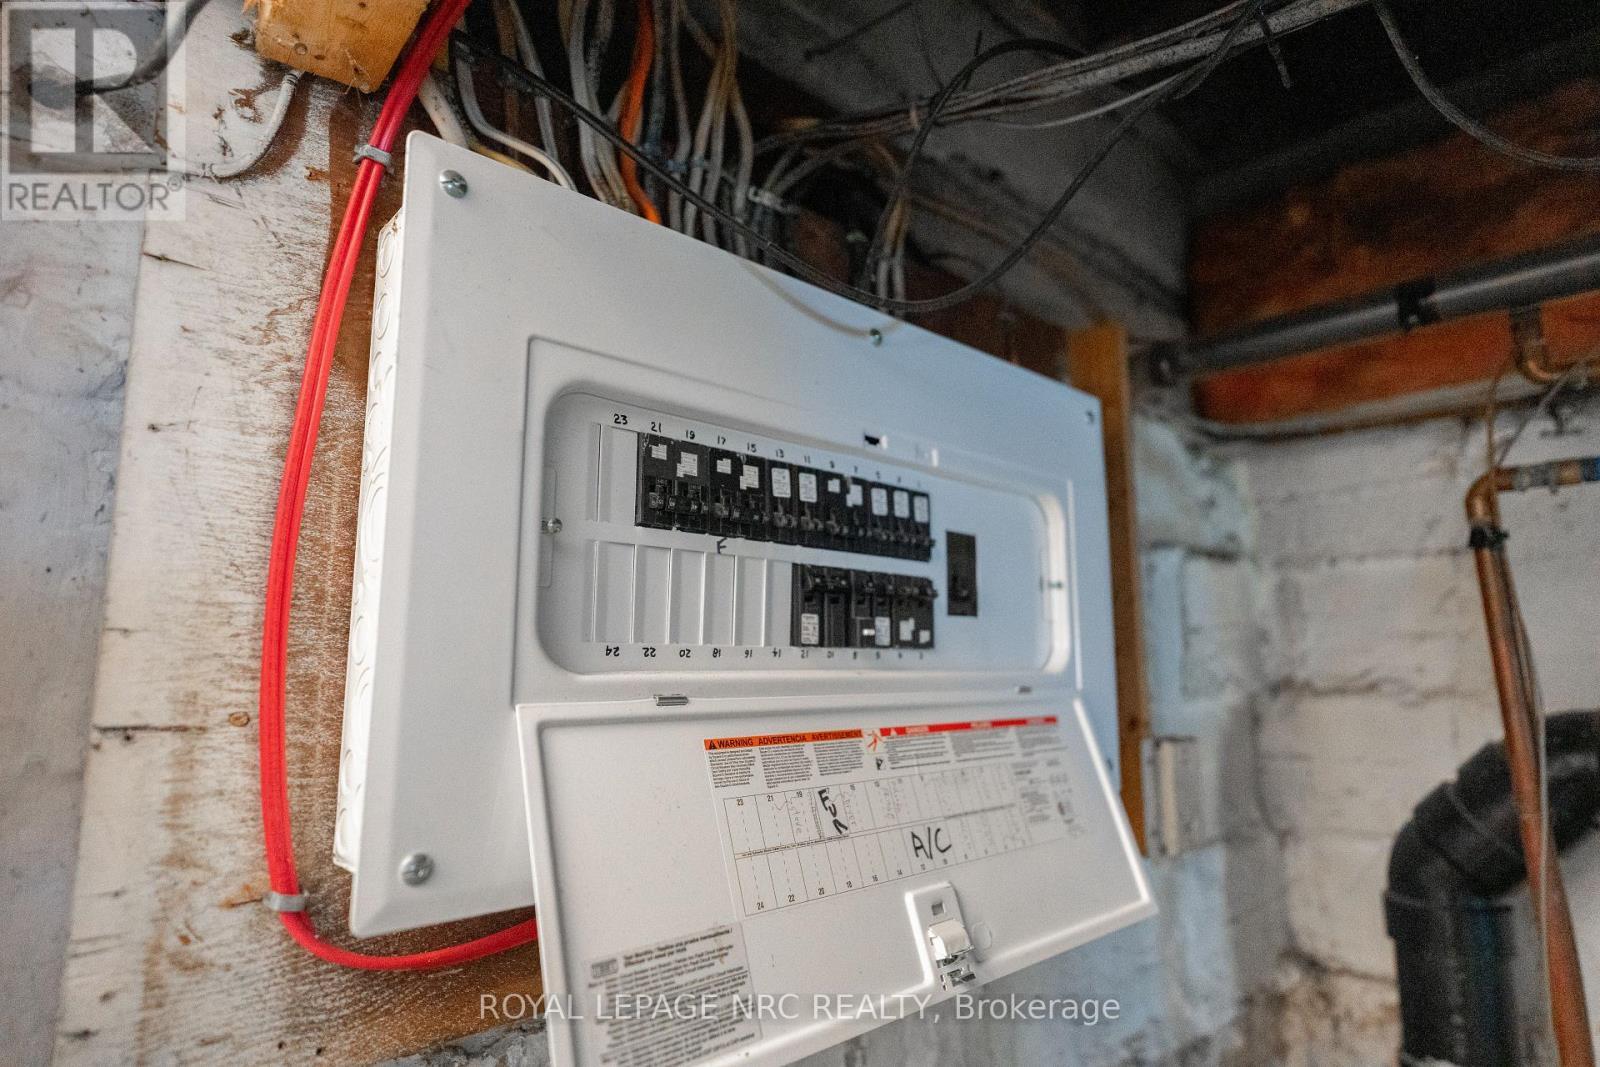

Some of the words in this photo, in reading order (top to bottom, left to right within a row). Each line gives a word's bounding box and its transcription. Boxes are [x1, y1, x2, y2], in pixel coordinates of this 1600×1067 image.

[613, 413, 628, 425] 23
[650, 421, 662, 433] 21
[685, 430, 696, 440] 19
[716, 435, 726, 445] 17
[746, 442, 757, 453] 15
[775, 448, 785, 459] 13
[605, 645, 620, 657] 24
[642, 647, 656, 658] 22
[679, 648, 691, 658] 20
[712, 648, 721, 658] 18
[744, 649, 753, 658] 16
[772, 647, 782, 658] 14
[717, 737, 754, 748] WARNING
[758, 732, 807, 746] ADVERTENCIA
[767, 794, 774, 802] 21
[757, 902, 765, 910] 24
[788, 894, 796, 903] 22
